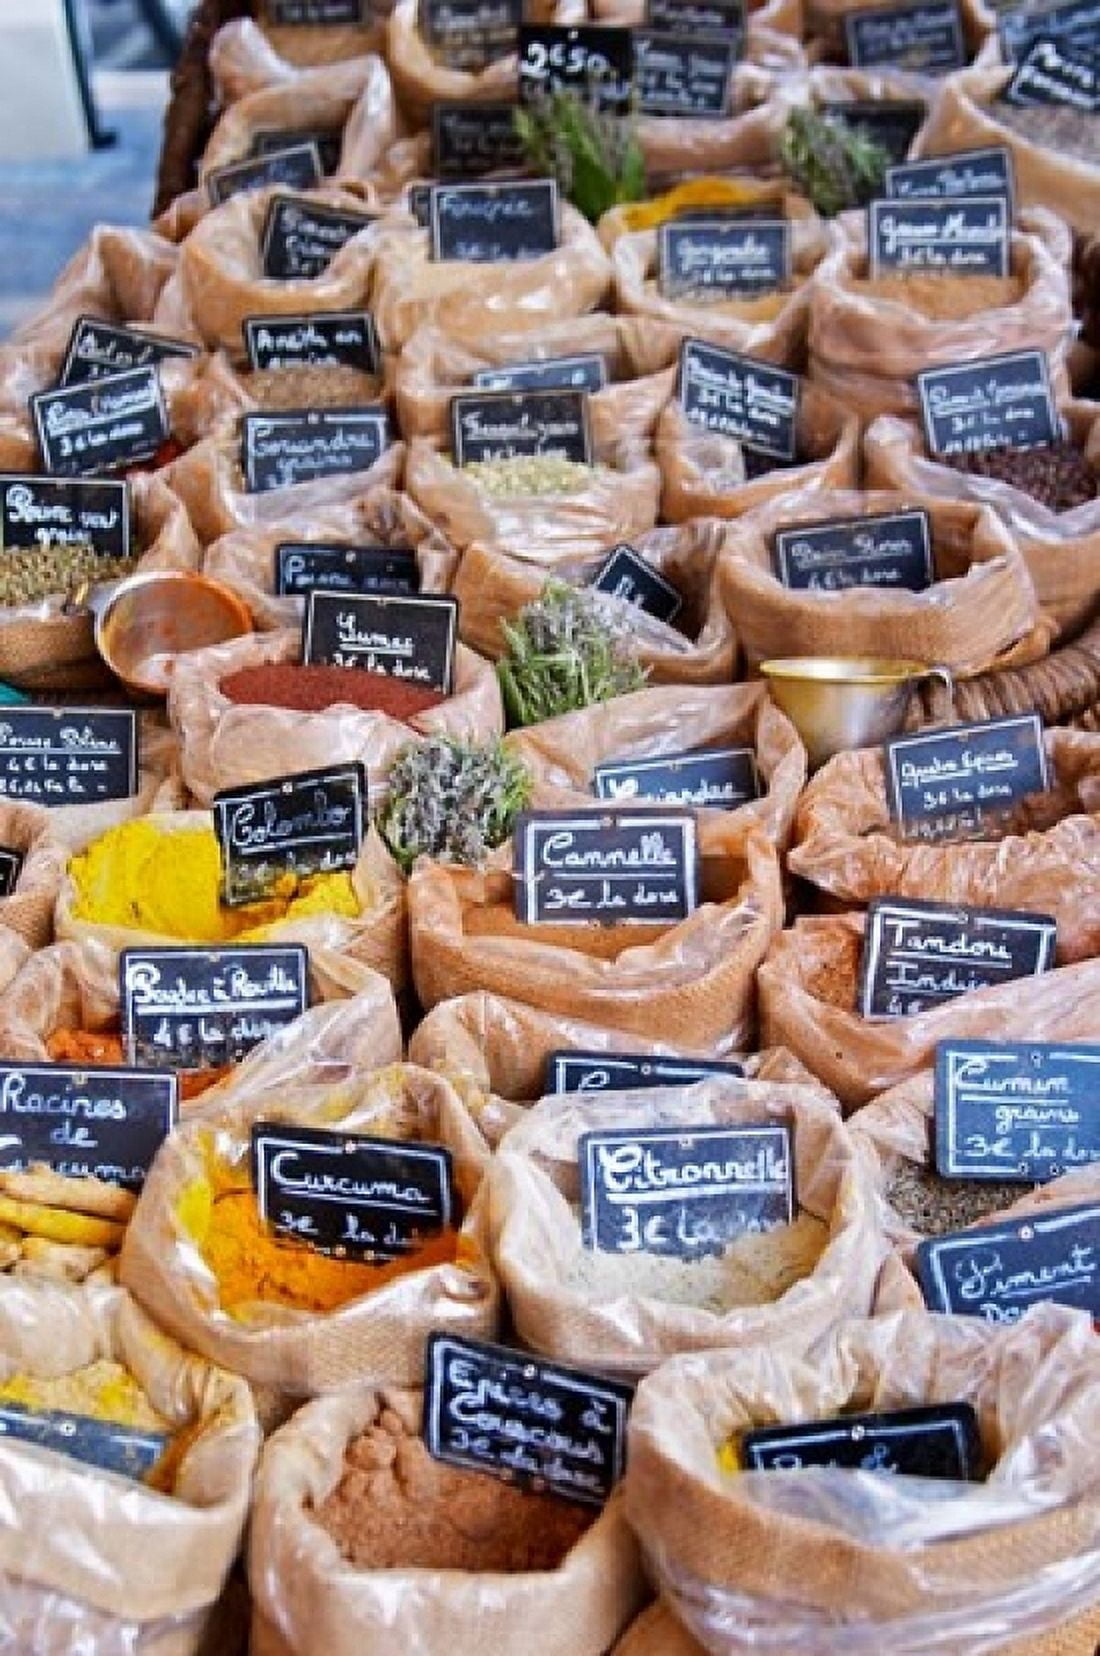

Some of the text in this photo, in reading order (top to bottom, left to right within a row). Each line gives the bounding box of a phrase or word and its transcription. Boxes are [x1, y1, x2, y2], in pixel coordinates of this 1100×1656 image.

[543, 831, 677, 867] Cannelle
[2, 1071, 128, 1120] Racines
[51, 1117, 99, 1149] de
[270, 1151, 432, 1204] Curcuma
